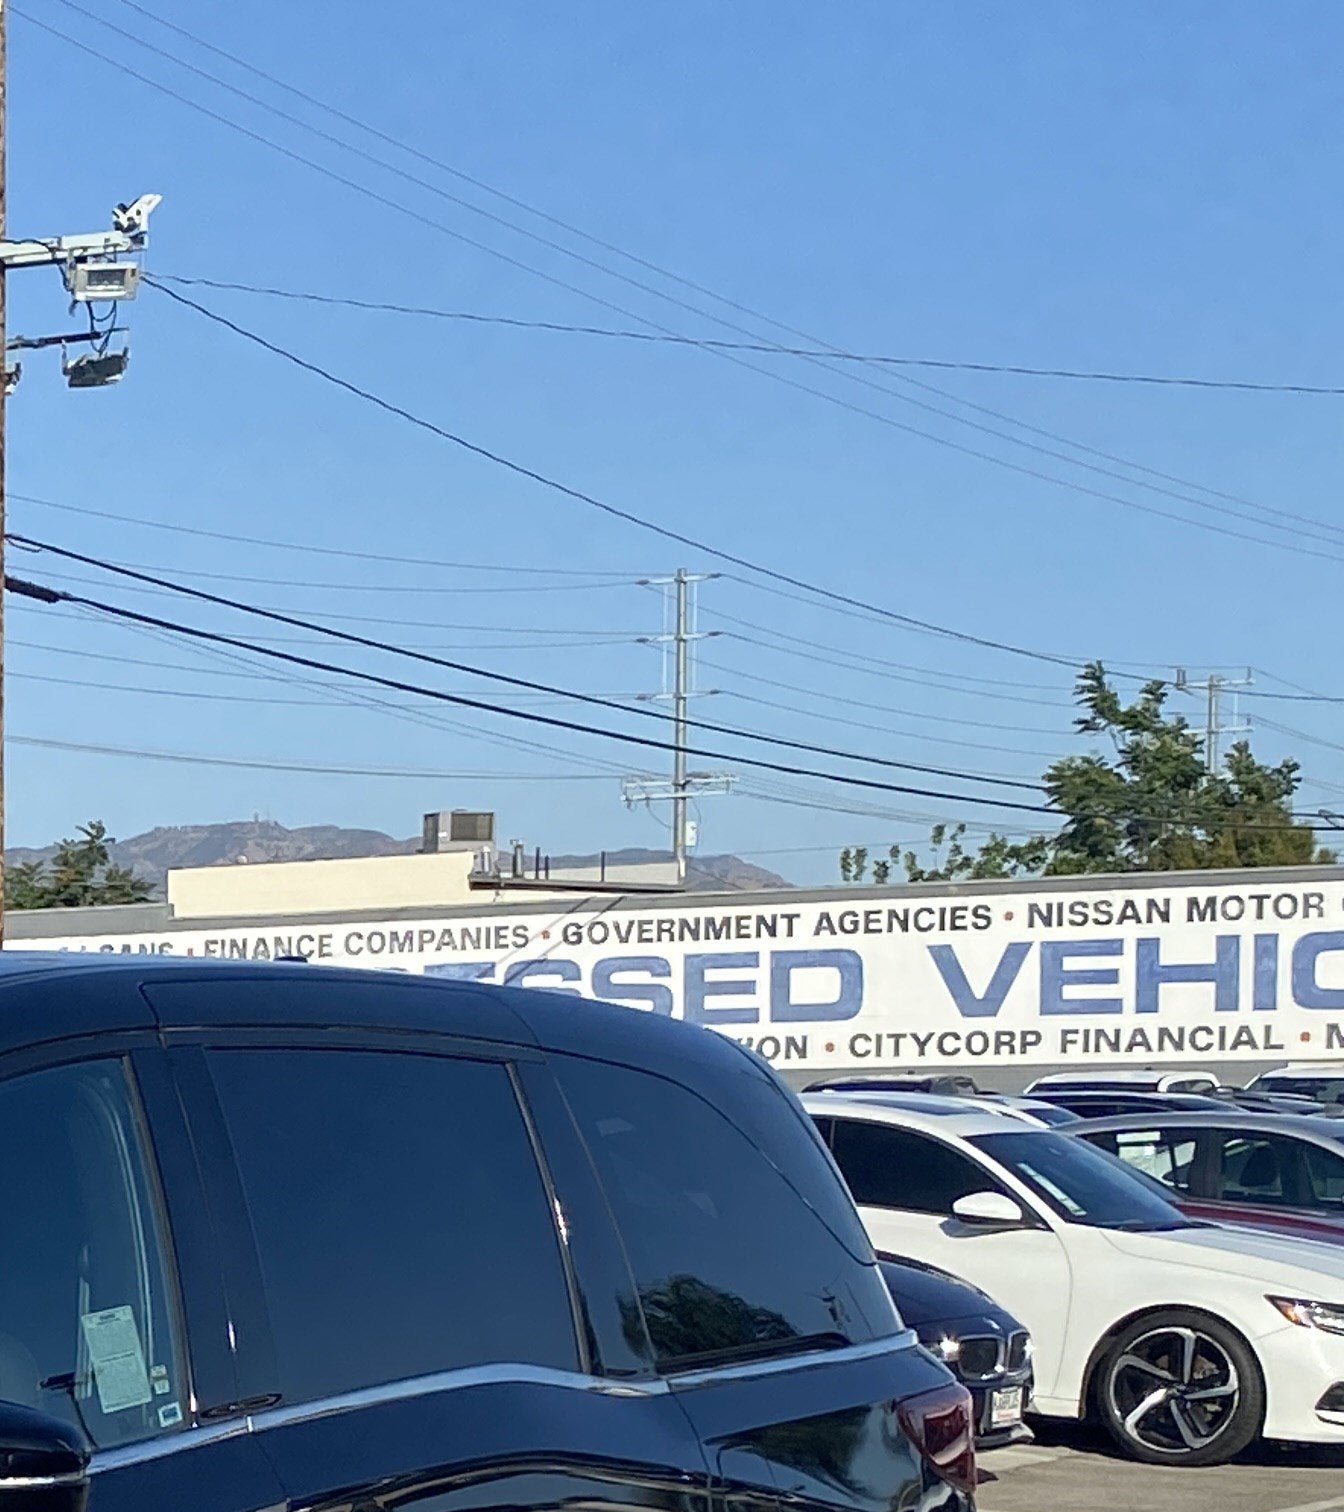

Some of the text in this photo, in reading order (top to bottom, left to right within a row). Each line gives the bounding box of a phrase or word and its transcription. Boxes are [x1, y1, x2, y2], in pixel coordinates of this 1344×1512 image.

[205, 933, 333, 960] FINANCE
[344, 925, 529, 955] COMPANIES
[562, 912, 801, 946] GOVERNMENT
[813, 904, 992, 937] AGENCIES
[1028, 897, 1171, 929] NISSAN
[1187, 892, 1324, 922] MOTOR
[927, 930, 1344, 1018] VEHIC
[849, 1030, 1042, 1058] CITYCORP
[1061, 1024, 1284, 1054] FINANCIAL
